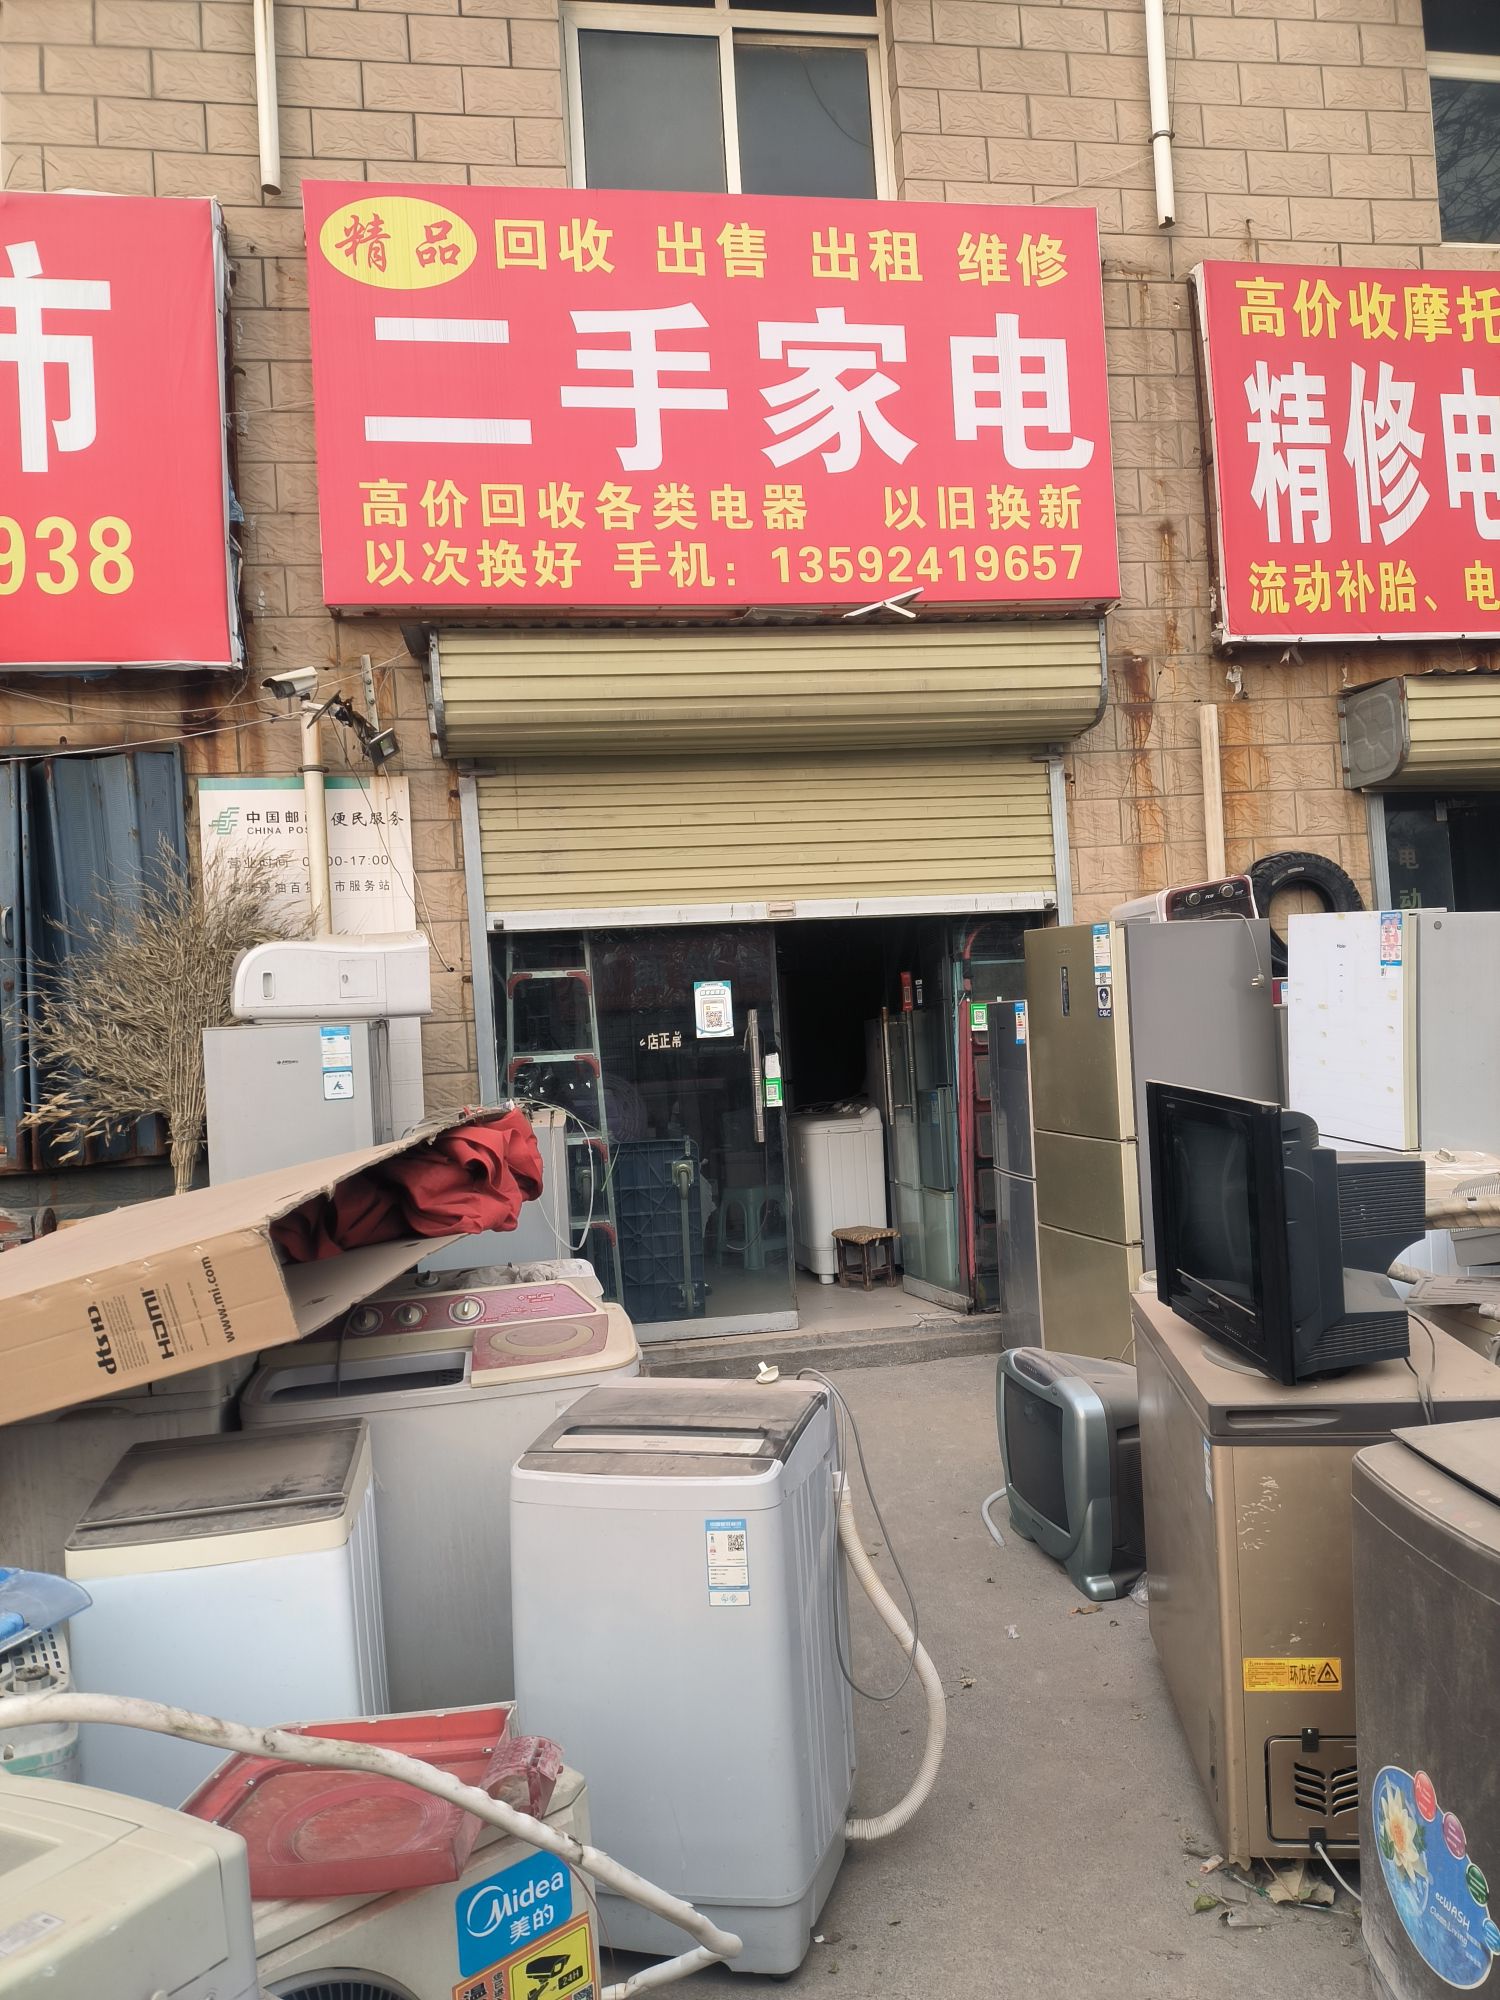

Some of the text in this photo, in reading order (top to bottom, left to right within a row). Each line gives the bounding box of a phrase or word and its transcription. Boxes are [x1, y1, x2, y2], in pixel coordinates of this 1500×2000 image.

[335, 213, 461, 273] 精品
[494, 219, 1068, 287] 回收 出售 出租 维修
[1235, 277, 1500, 344] 高价收摩托
[0, 241, 111, 474] 市
[364, 302, 1095, 474] 二手家电
[1243, 360, 1500, 546] 精修电
[359, 479, 1082, 531] 高价回收各类电器 以旧换新
[366, 540, 582, 589] 以次换好
[771, 543, 1084, 584] 13592419657
[246, 810, 404, 827] 中国邮 便民服务
[247, 827, 281, 835] CHINA
[141, 1289, 175, 1360] HDMI
[201, 1256, 235, 1343] www.mi.com
[96, 1333, 117, 1375] dts
[466, 1872, 564, 1938] Midea
[509, 1903, 555, 1945] 美的
[562, 1970, 580, 1986] 24H
